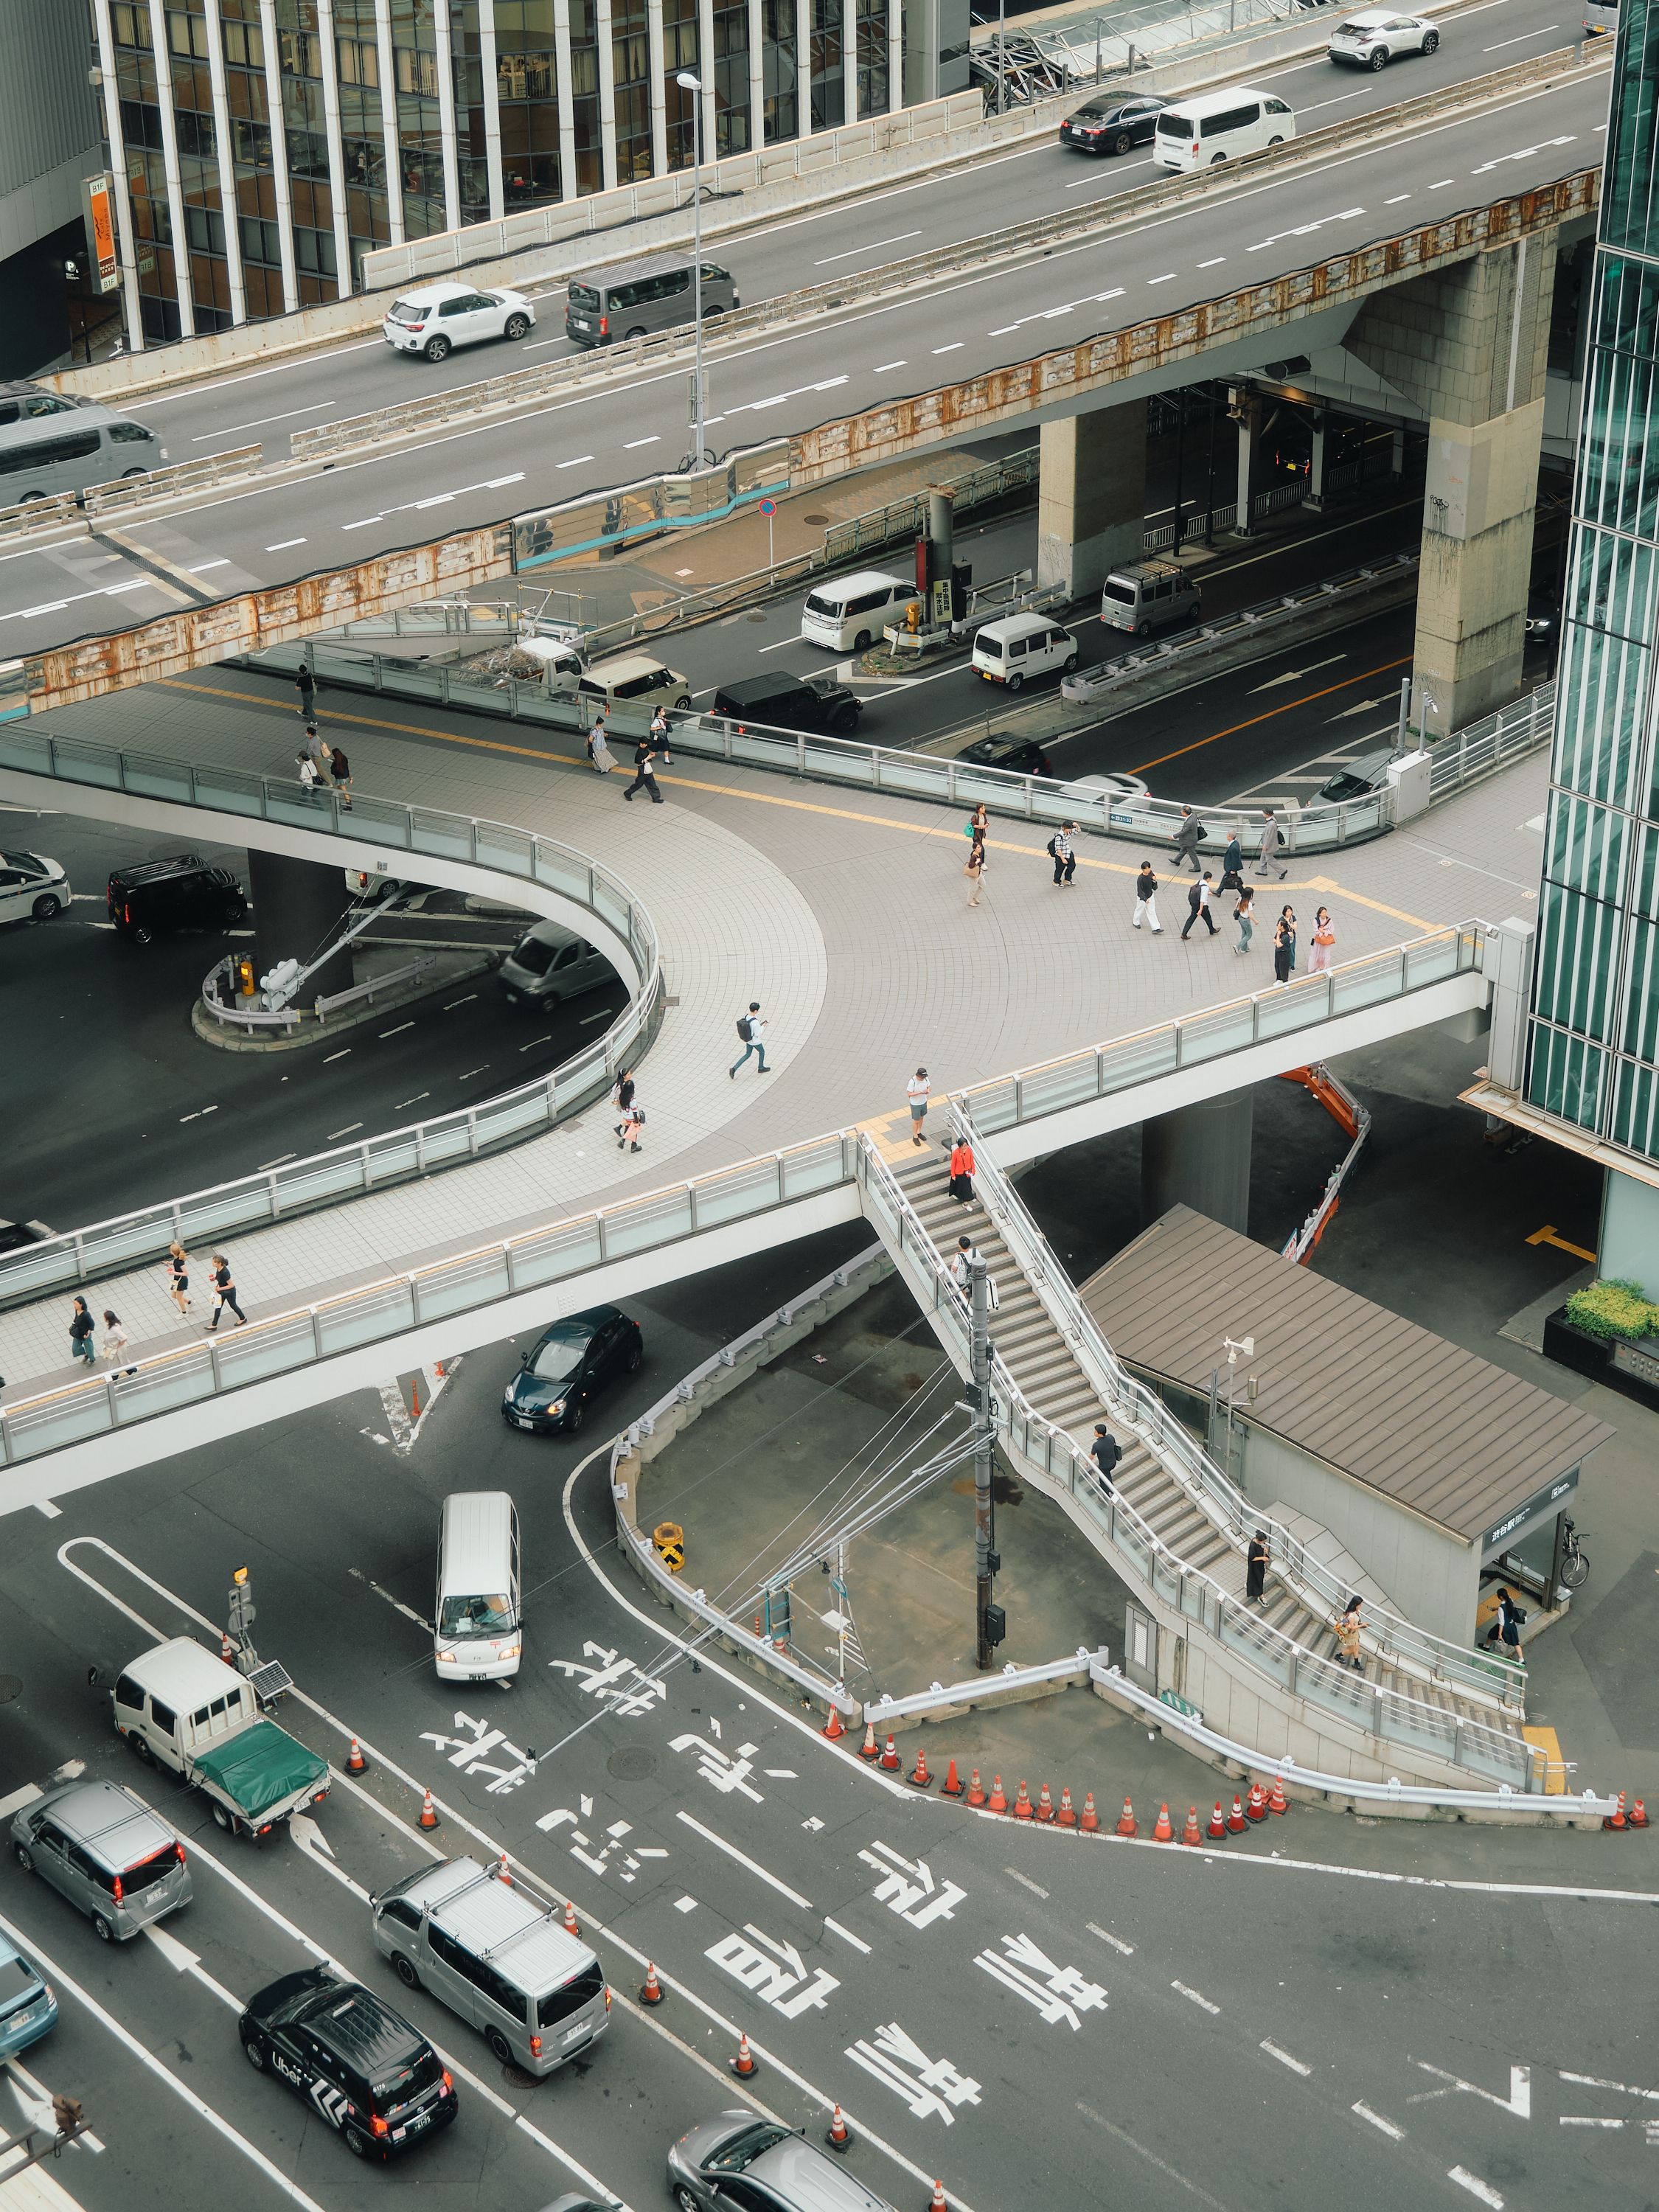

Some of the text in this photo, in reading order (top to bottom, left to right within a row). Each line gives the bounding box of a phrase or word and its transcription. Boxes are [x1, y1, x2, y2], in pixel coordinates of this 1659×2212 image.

[92, 182, 104, 193] B1F
[103, 279, 115, 288] B1F
[1492, 1517, 1515, 1542] 渋谷駅
[272, 2051, 302, 2087] Uber
